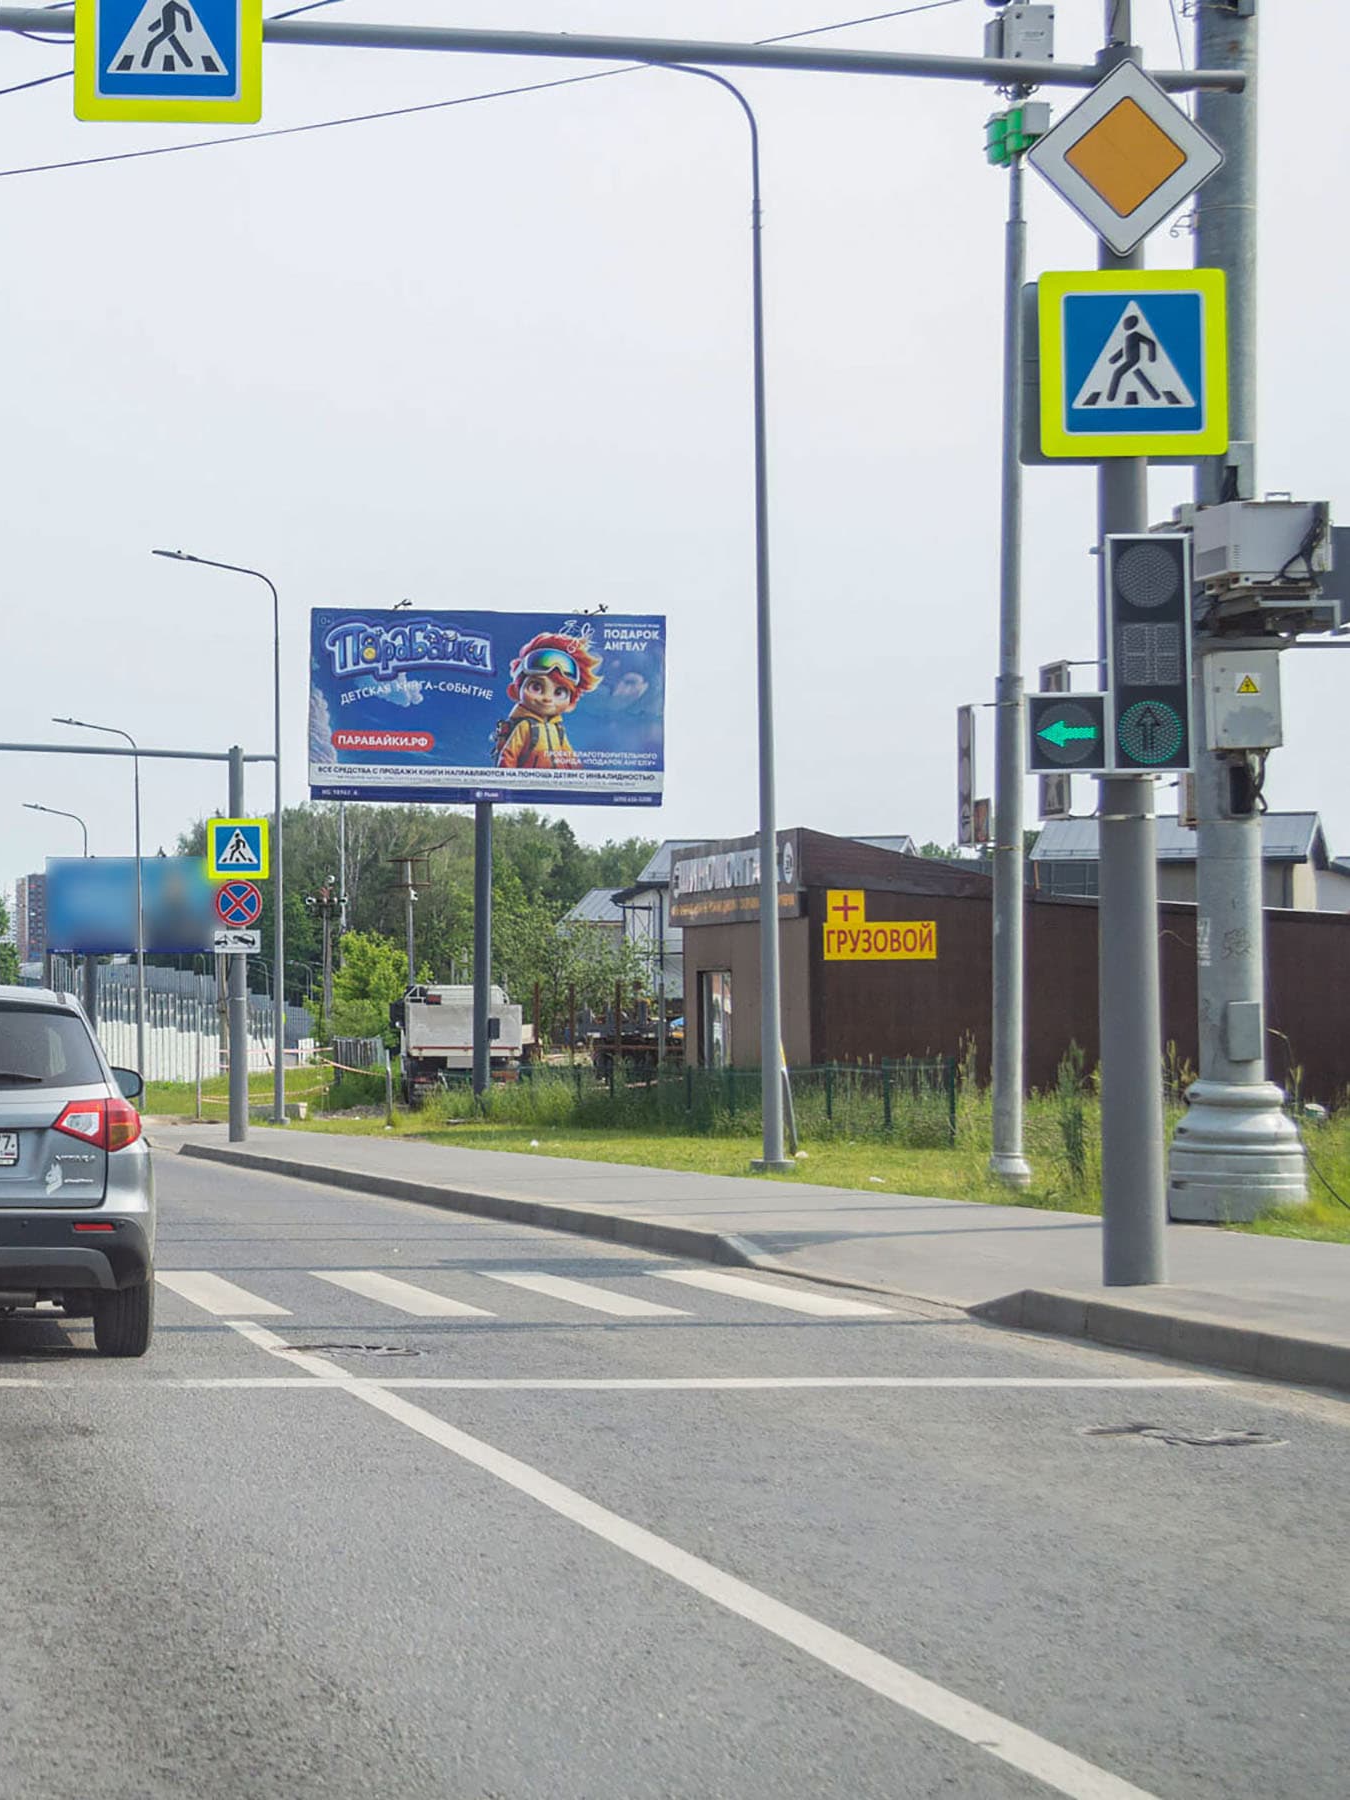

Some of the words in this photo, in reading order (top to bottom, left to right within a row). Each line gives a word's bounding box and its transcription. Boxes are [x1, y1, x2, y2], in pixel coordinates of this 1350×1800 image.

[604, 629, 659, 640] ПОДАРОК
[604, 641, 647, 651] АНГЕЛУ
[340, 684, 392, 705] ДЕТСКАЯ
[337, 735, 428, 747] ПАРАБАЙКИ.РФ
[333, 767, 371, 775] СРЕДСТВА
[379, 768, 417, 776] ПРОДАЖИ
[419, 769, 443, 777] КНИГИ
[444, 770, 505, 778] НАПРАВЛЯЮТСЯ
[518, 771, 552, 779] ПОМОЩЬ
[679, 848, 782, 894] ШИНОМОНТА
[826, 923, 933, 953] ГРУЗОВОЙ
